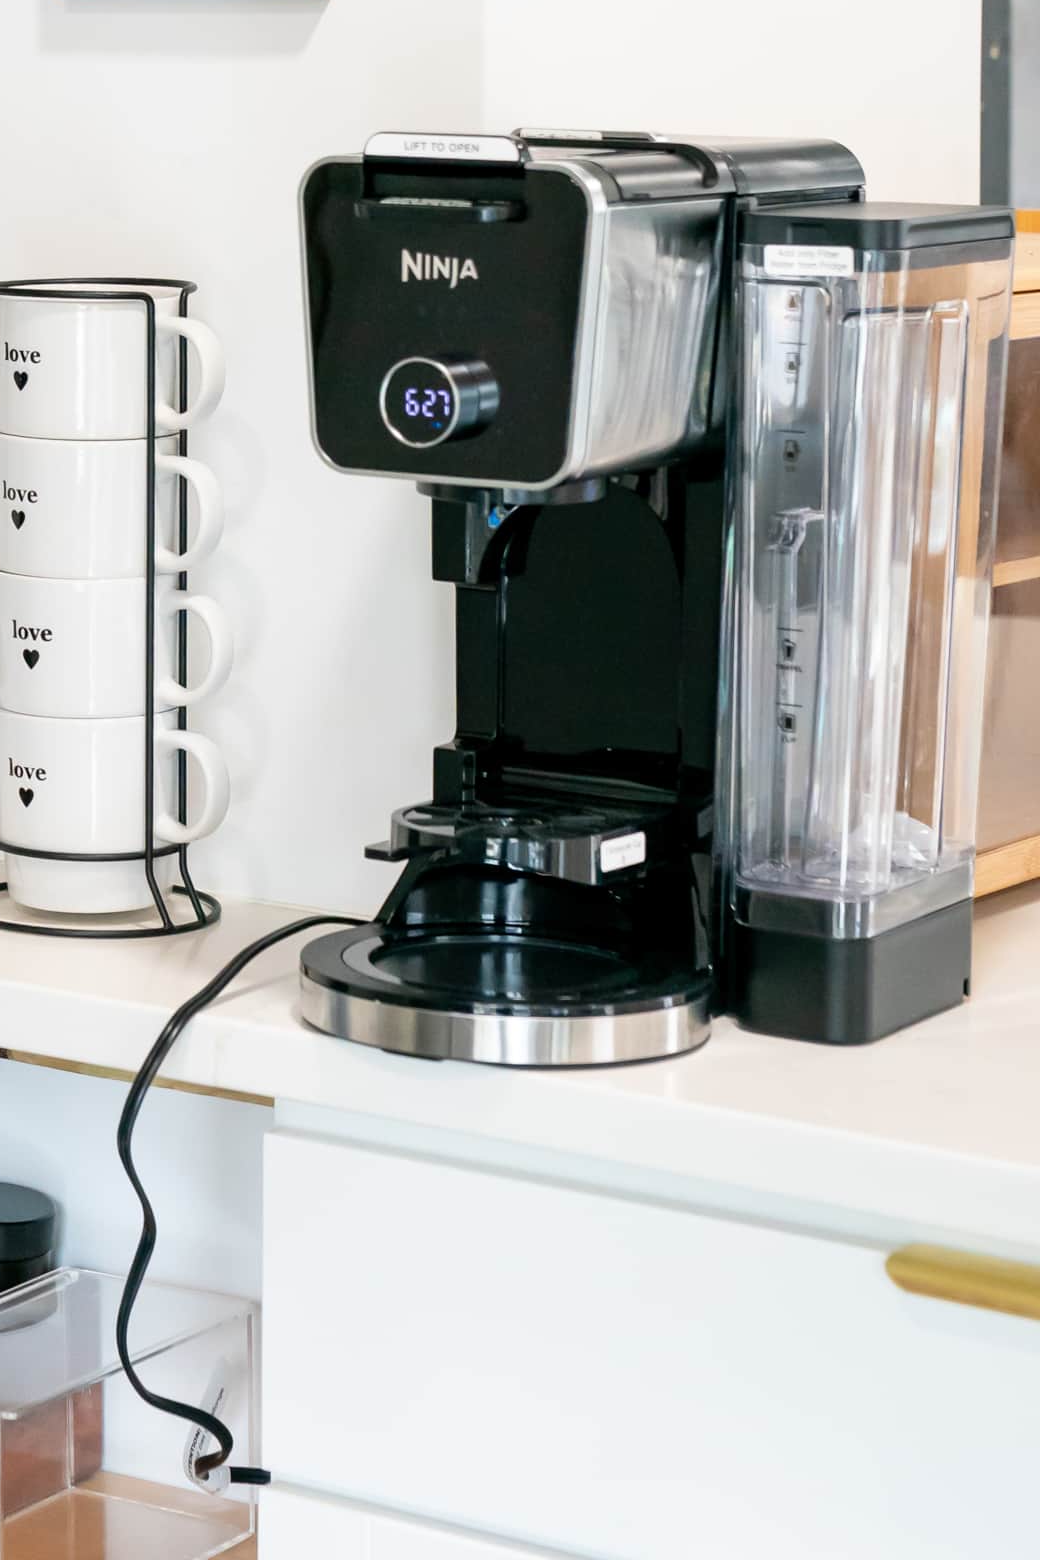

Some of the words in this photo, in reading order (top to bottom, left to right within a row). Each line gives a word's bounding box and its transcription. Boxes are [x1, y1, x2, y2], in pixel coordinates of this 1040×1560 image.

[403, 141, 428, 152] LIFT
[432, 142, 446, 153] TO
[449, 143, 480, 153] OPEN
[400, 248, 479, 289] NINJA
[4, 342, 42, 365] love
[2, 481, 39, 505] love
[11, 620, 53, 644] love
[8, 757, 48, 782] love
